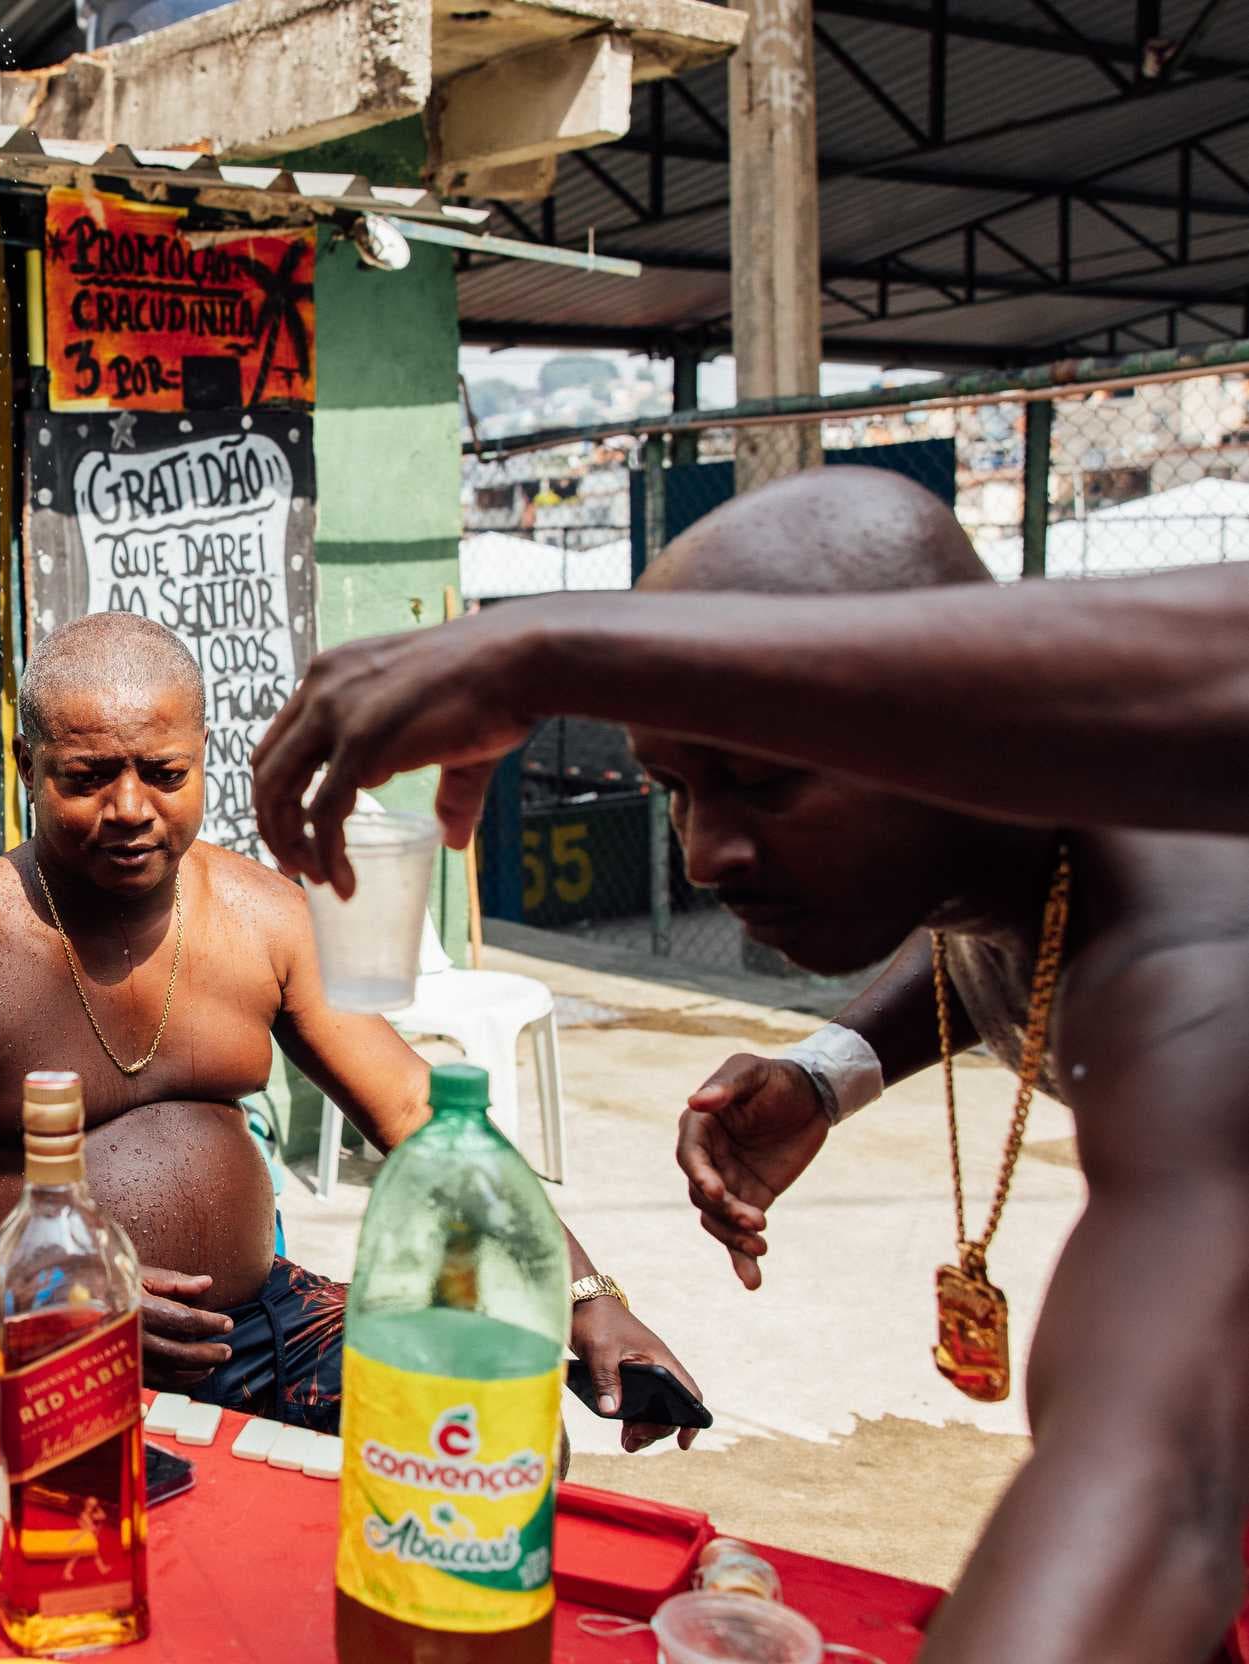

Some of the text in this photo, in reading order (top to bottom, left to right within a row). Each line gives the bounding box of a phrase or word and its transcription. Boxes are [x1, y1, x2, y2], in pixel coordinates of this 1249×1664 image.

[64, 339, 100, 396] 3
[111, 536, 169, 578] QUE
[160, 577, 284, 630] SENHOR
[19, 1391, 65, 1425] RED
[68, 1353, 138, 1400] LABEL
